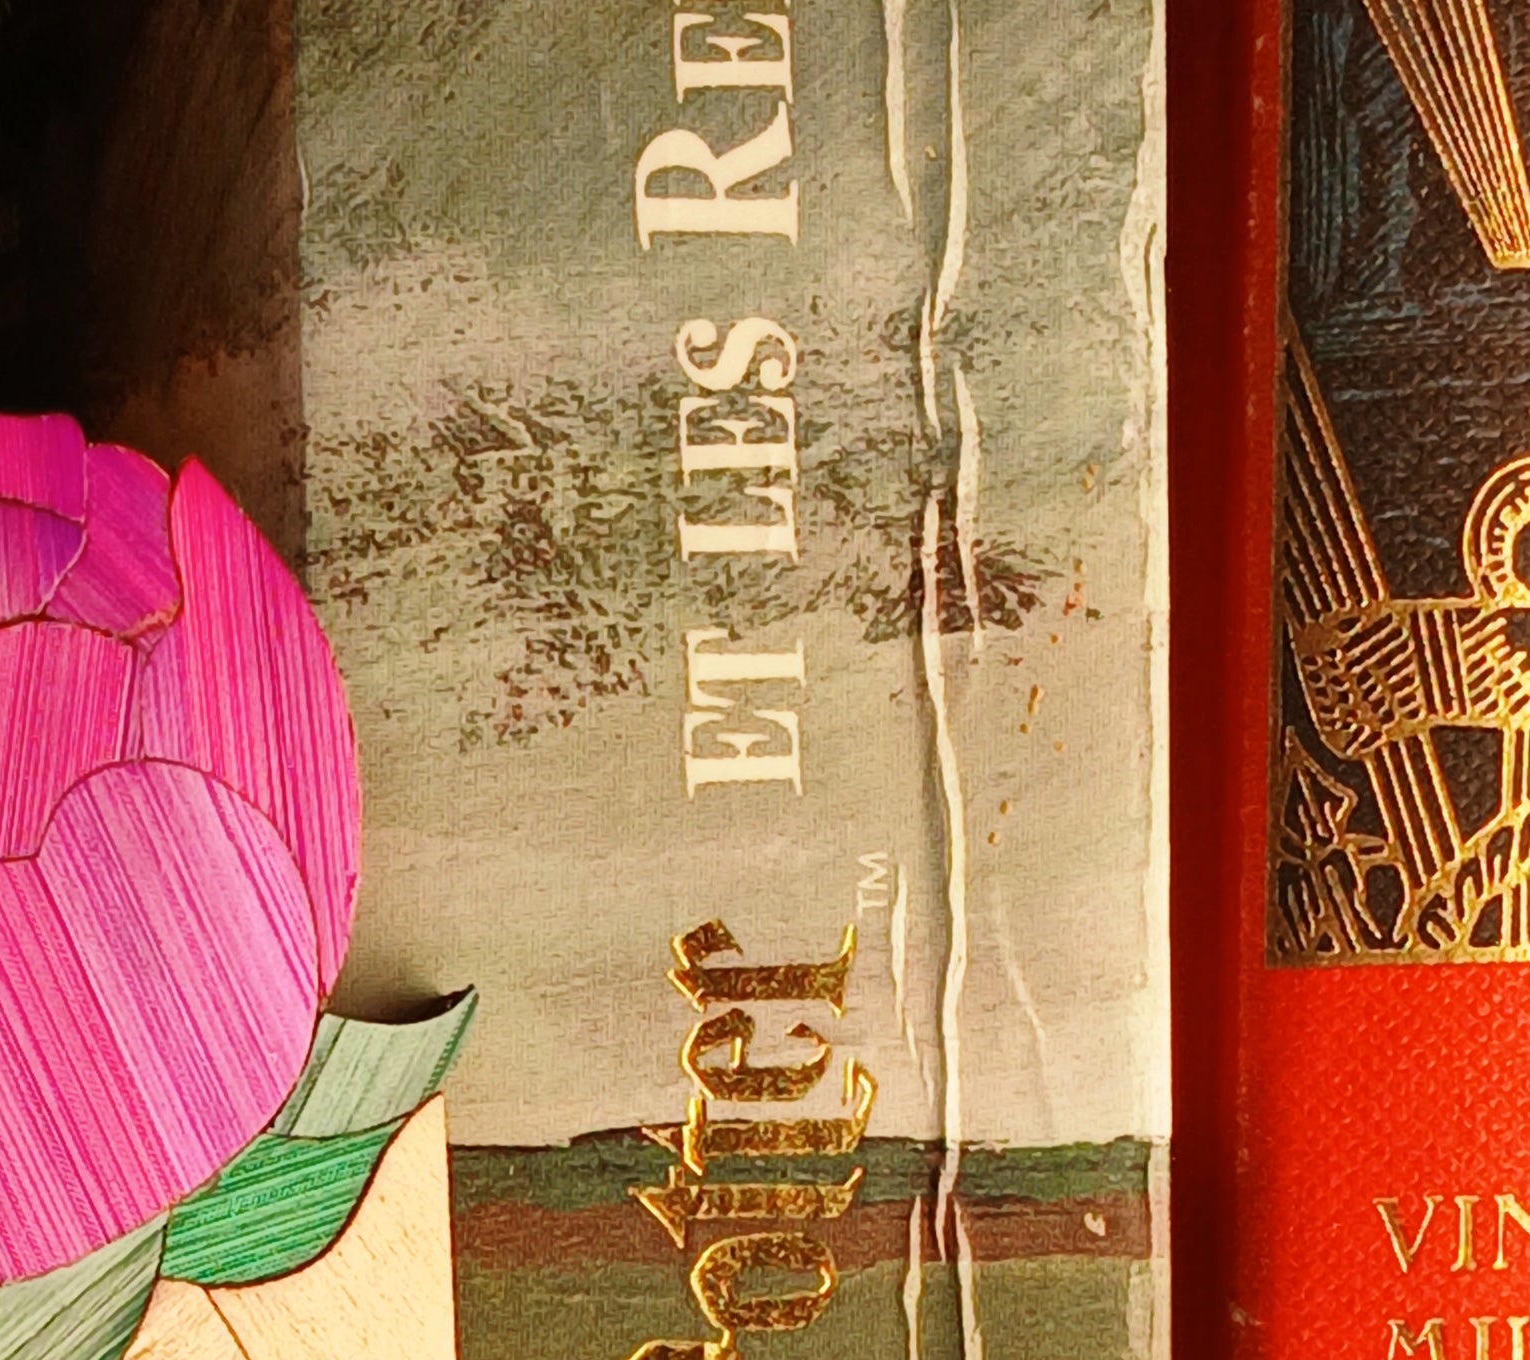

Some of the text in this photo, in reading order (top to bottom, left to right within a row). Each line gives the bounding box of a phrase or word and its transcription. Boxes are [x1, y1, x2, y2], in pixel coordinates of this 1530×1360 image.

[635, 0, 799, 251] RE
[675, 316, 799, 563] LES
[683, 626, 806, 798] ET
